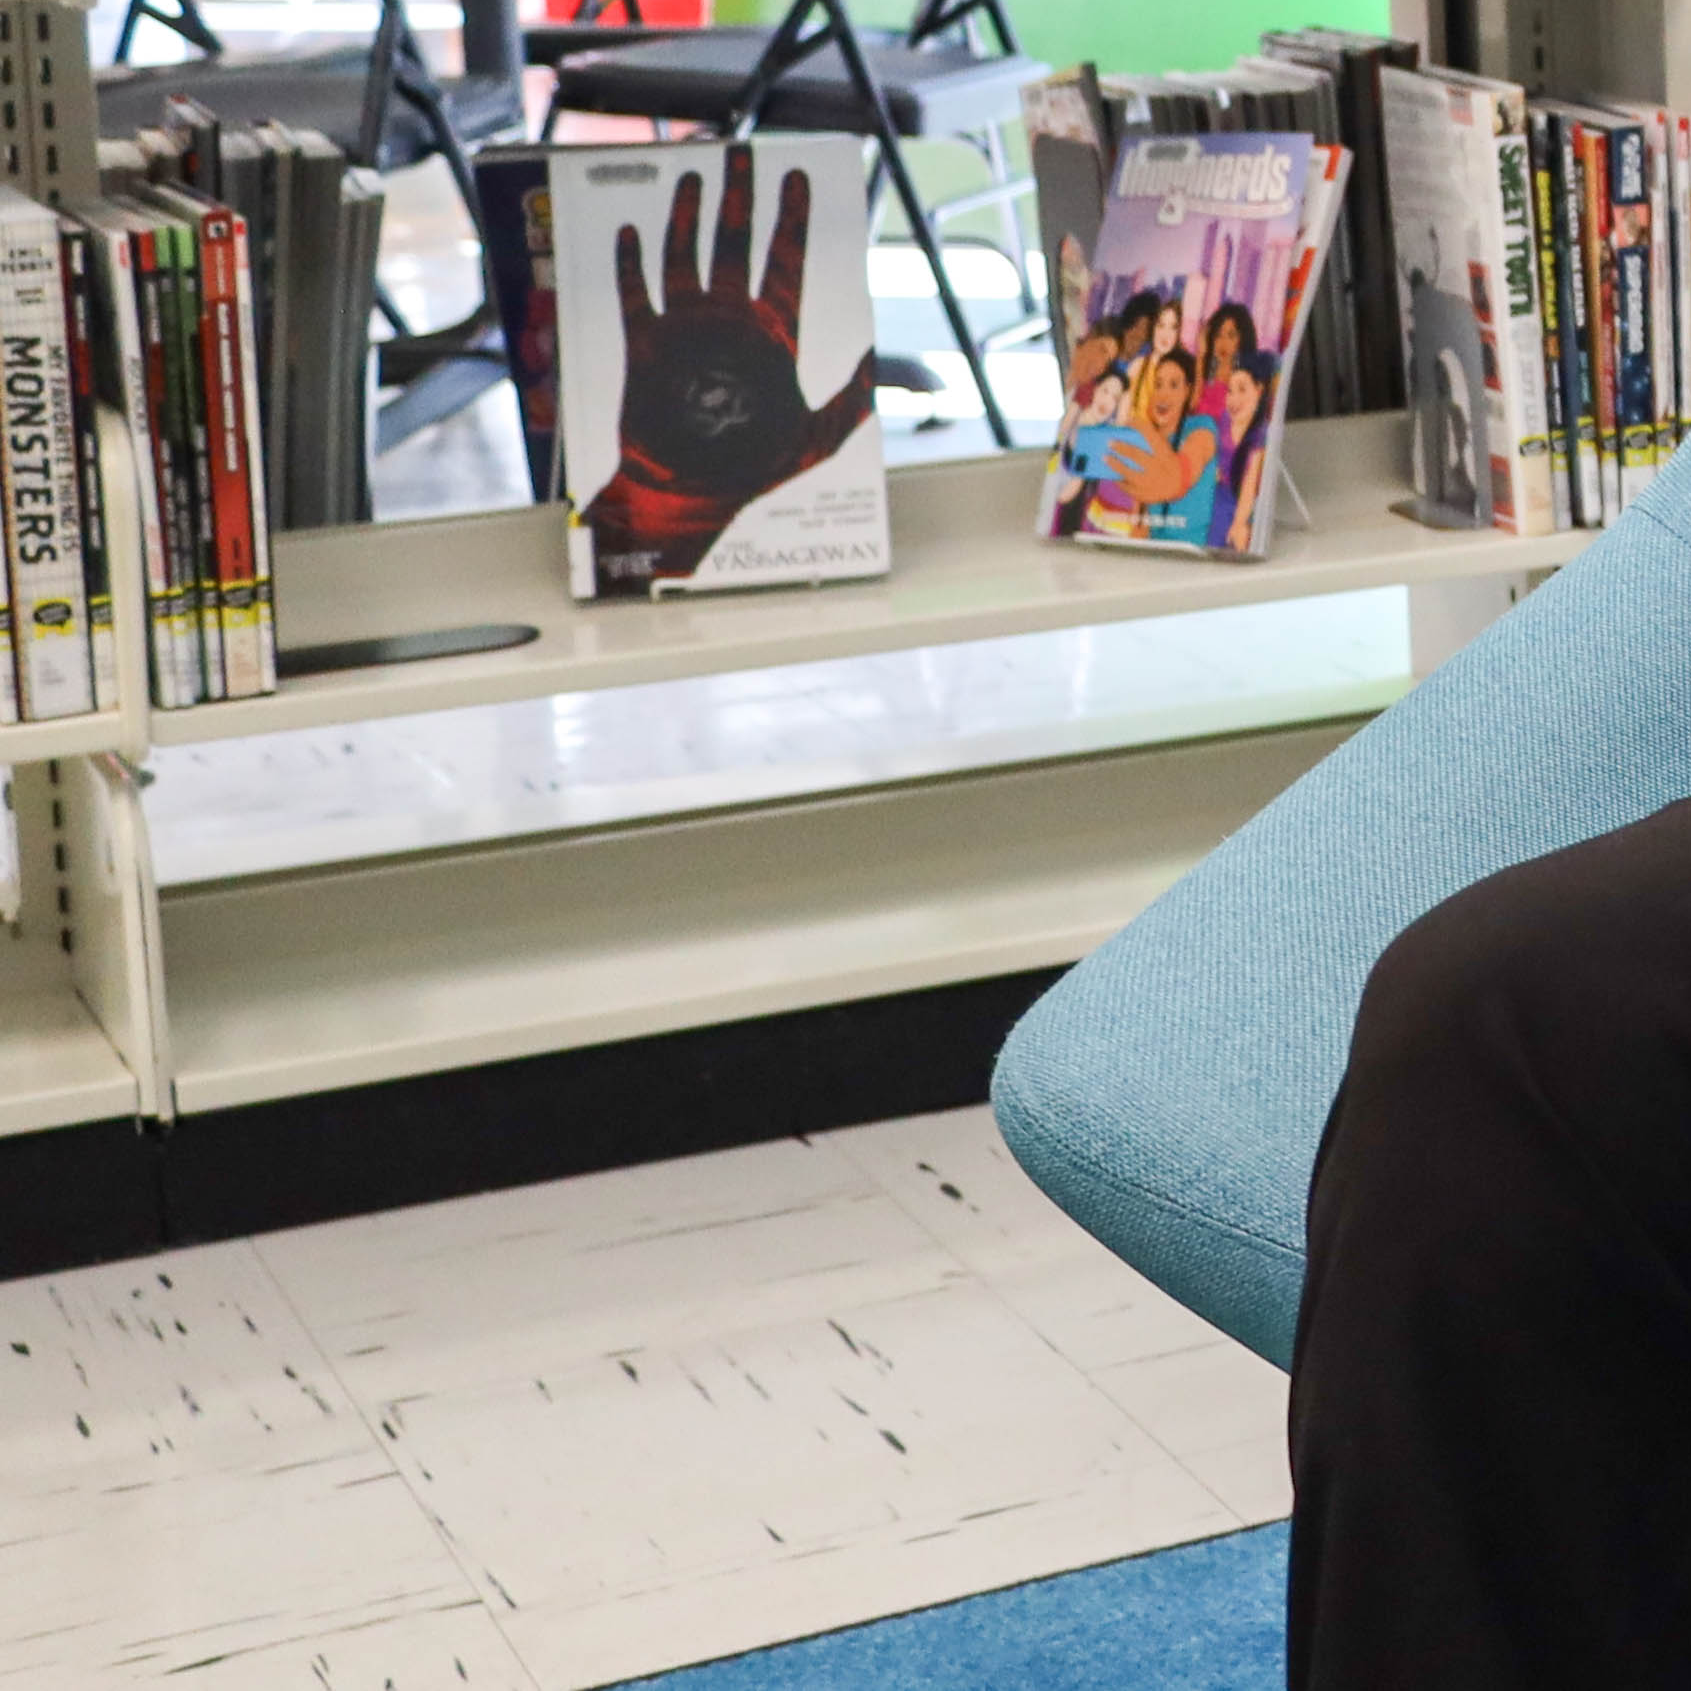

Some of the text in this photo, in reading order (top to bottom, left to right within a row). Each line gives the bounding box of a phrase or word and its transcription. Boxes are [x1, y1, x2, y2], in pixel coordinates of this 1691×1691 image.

[1498, 144, 1528, 228] SWEET
[48, 345, 65, 371] MY
[2, 336, 57, 565] MONSTERS
[51, 377, 73, 463] FAVORITE
[57, 474, 77, 527] THING
[712, 542, 882, 572] PASSAGEWAY
